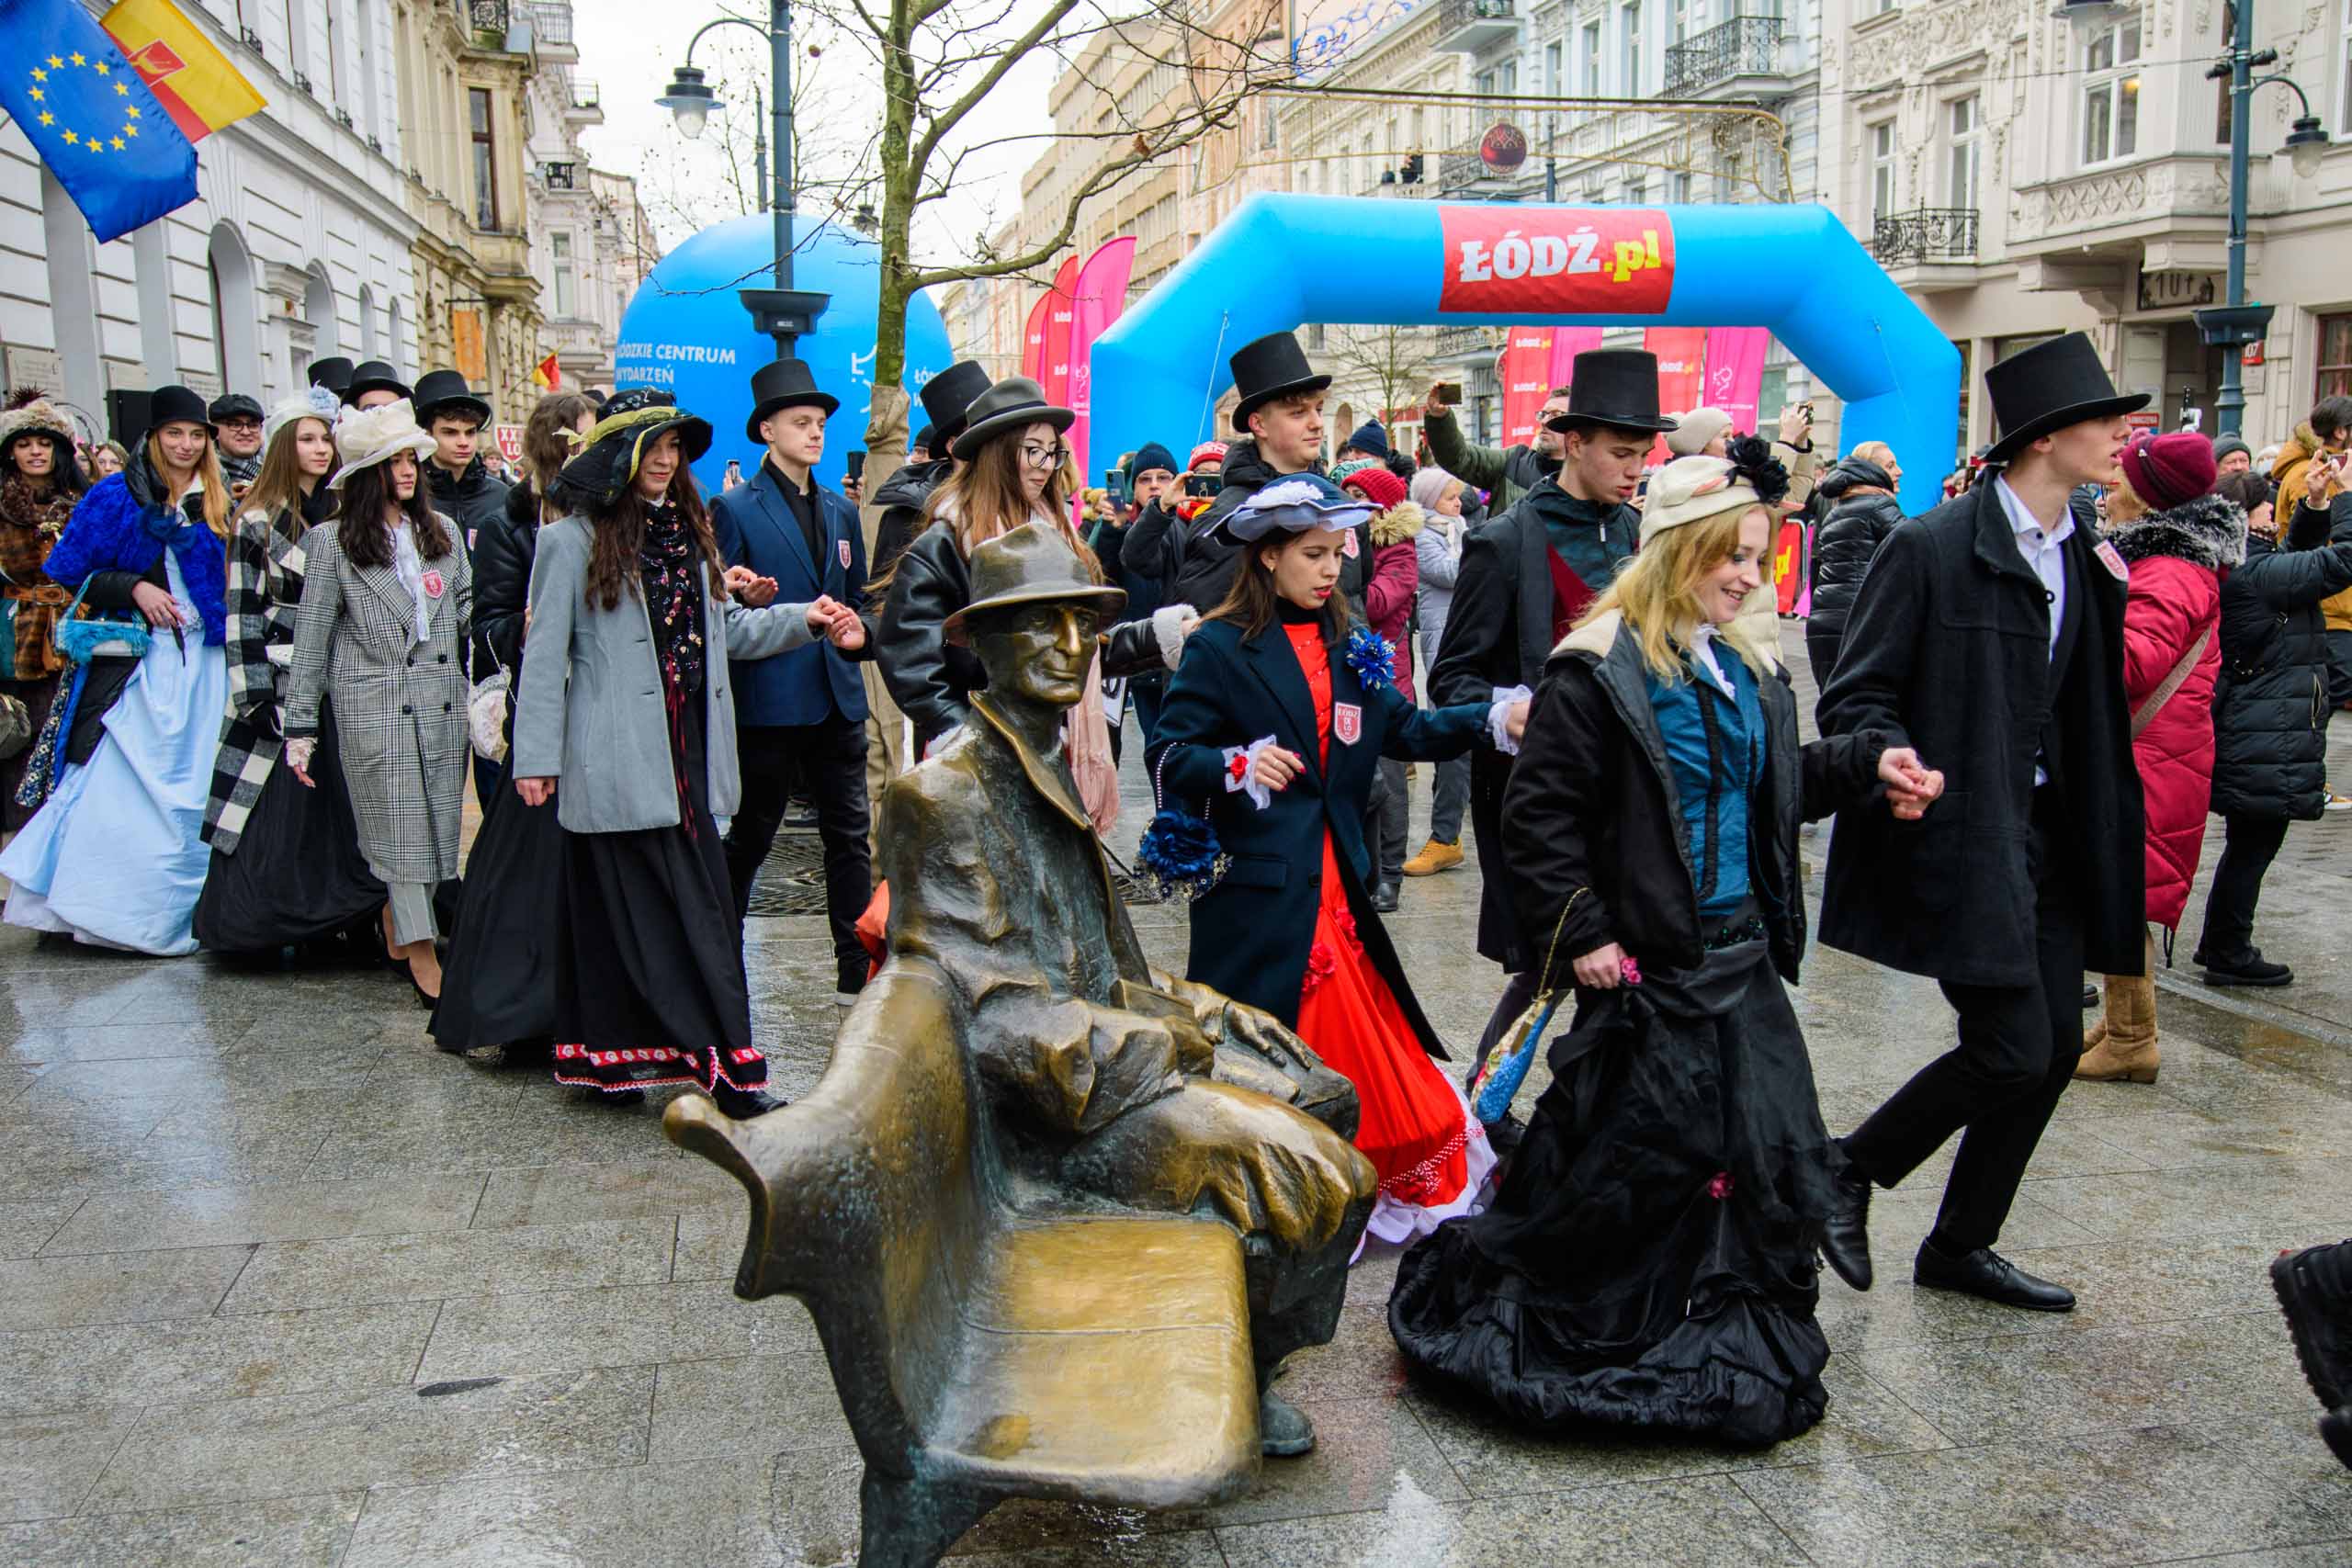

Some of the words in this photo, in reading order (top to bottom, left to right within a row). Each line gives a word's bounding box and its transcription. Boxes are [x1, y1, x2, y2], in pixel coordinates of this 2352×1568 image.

[1459, 225, 1662, 283] ŁÓDŹ.pl
[655, 344, 736, 365] CENTRUM
[506, 443, 522, 457] LO
